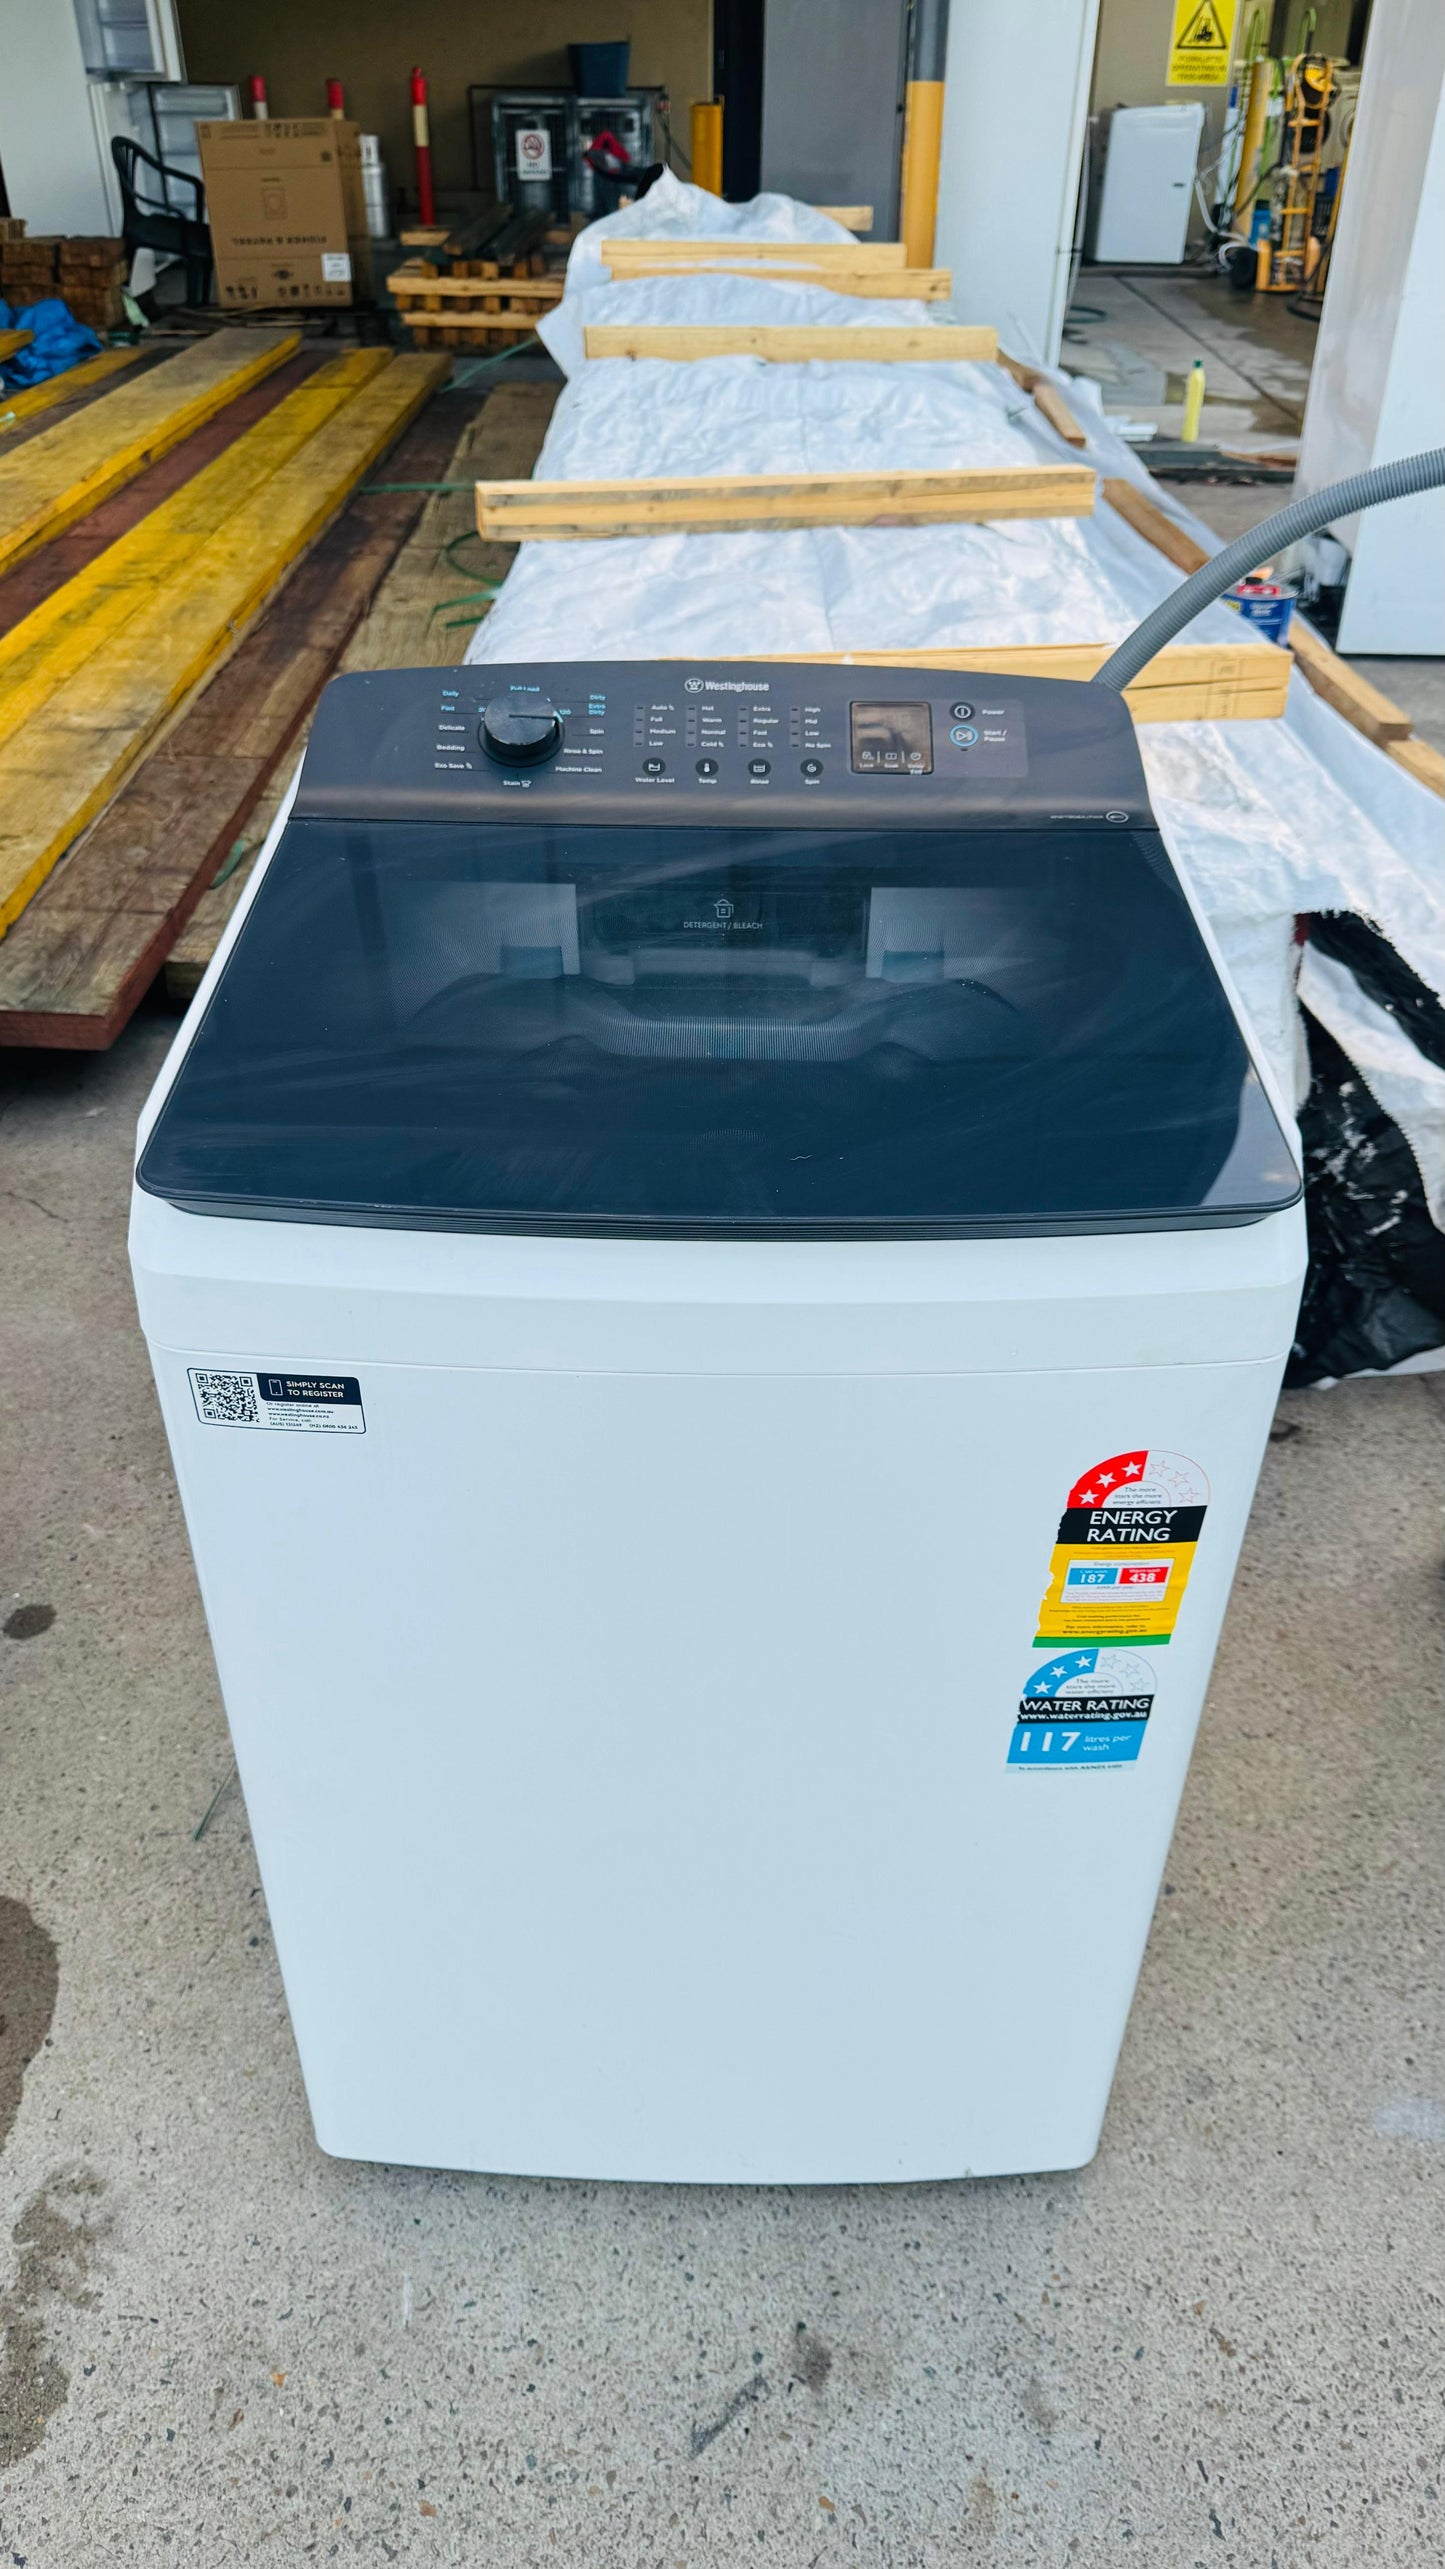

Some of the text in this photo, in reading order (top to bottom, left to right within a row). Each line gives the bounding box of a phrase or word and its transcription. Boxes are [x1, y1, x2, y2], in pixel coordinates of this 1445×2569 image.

[705, 681, 770, 692] Westinghouse
[981, 708, 1005, 716] Power
[589, 728, 605, 736] Spin
[436, 744, 466, 752] Bedding
[683, 921, 727, 929] DETERGENT
[732, 922, 764, 930] BLEACH
[286, 1380, 346, 1390] SIMPLY SCAN
[287, 1389, 345, 1398] TO REGISTER
[1089, 1510, 1178, 1525] ENERGY
[1086, 1527, 1172, 1542] RATING
[1080, 1573, 1106, 1584] 187
[1129, 1572, 1157, 1584] 438
[1022, 1698, 1150, 1711] WATER RATING
[1020, 1711, 1148, 1721] www.waterrating.gov.au
[1020, 1731, 1132, 1752] 117 litres per
[1082, 1743, 1110, 1752] wash
